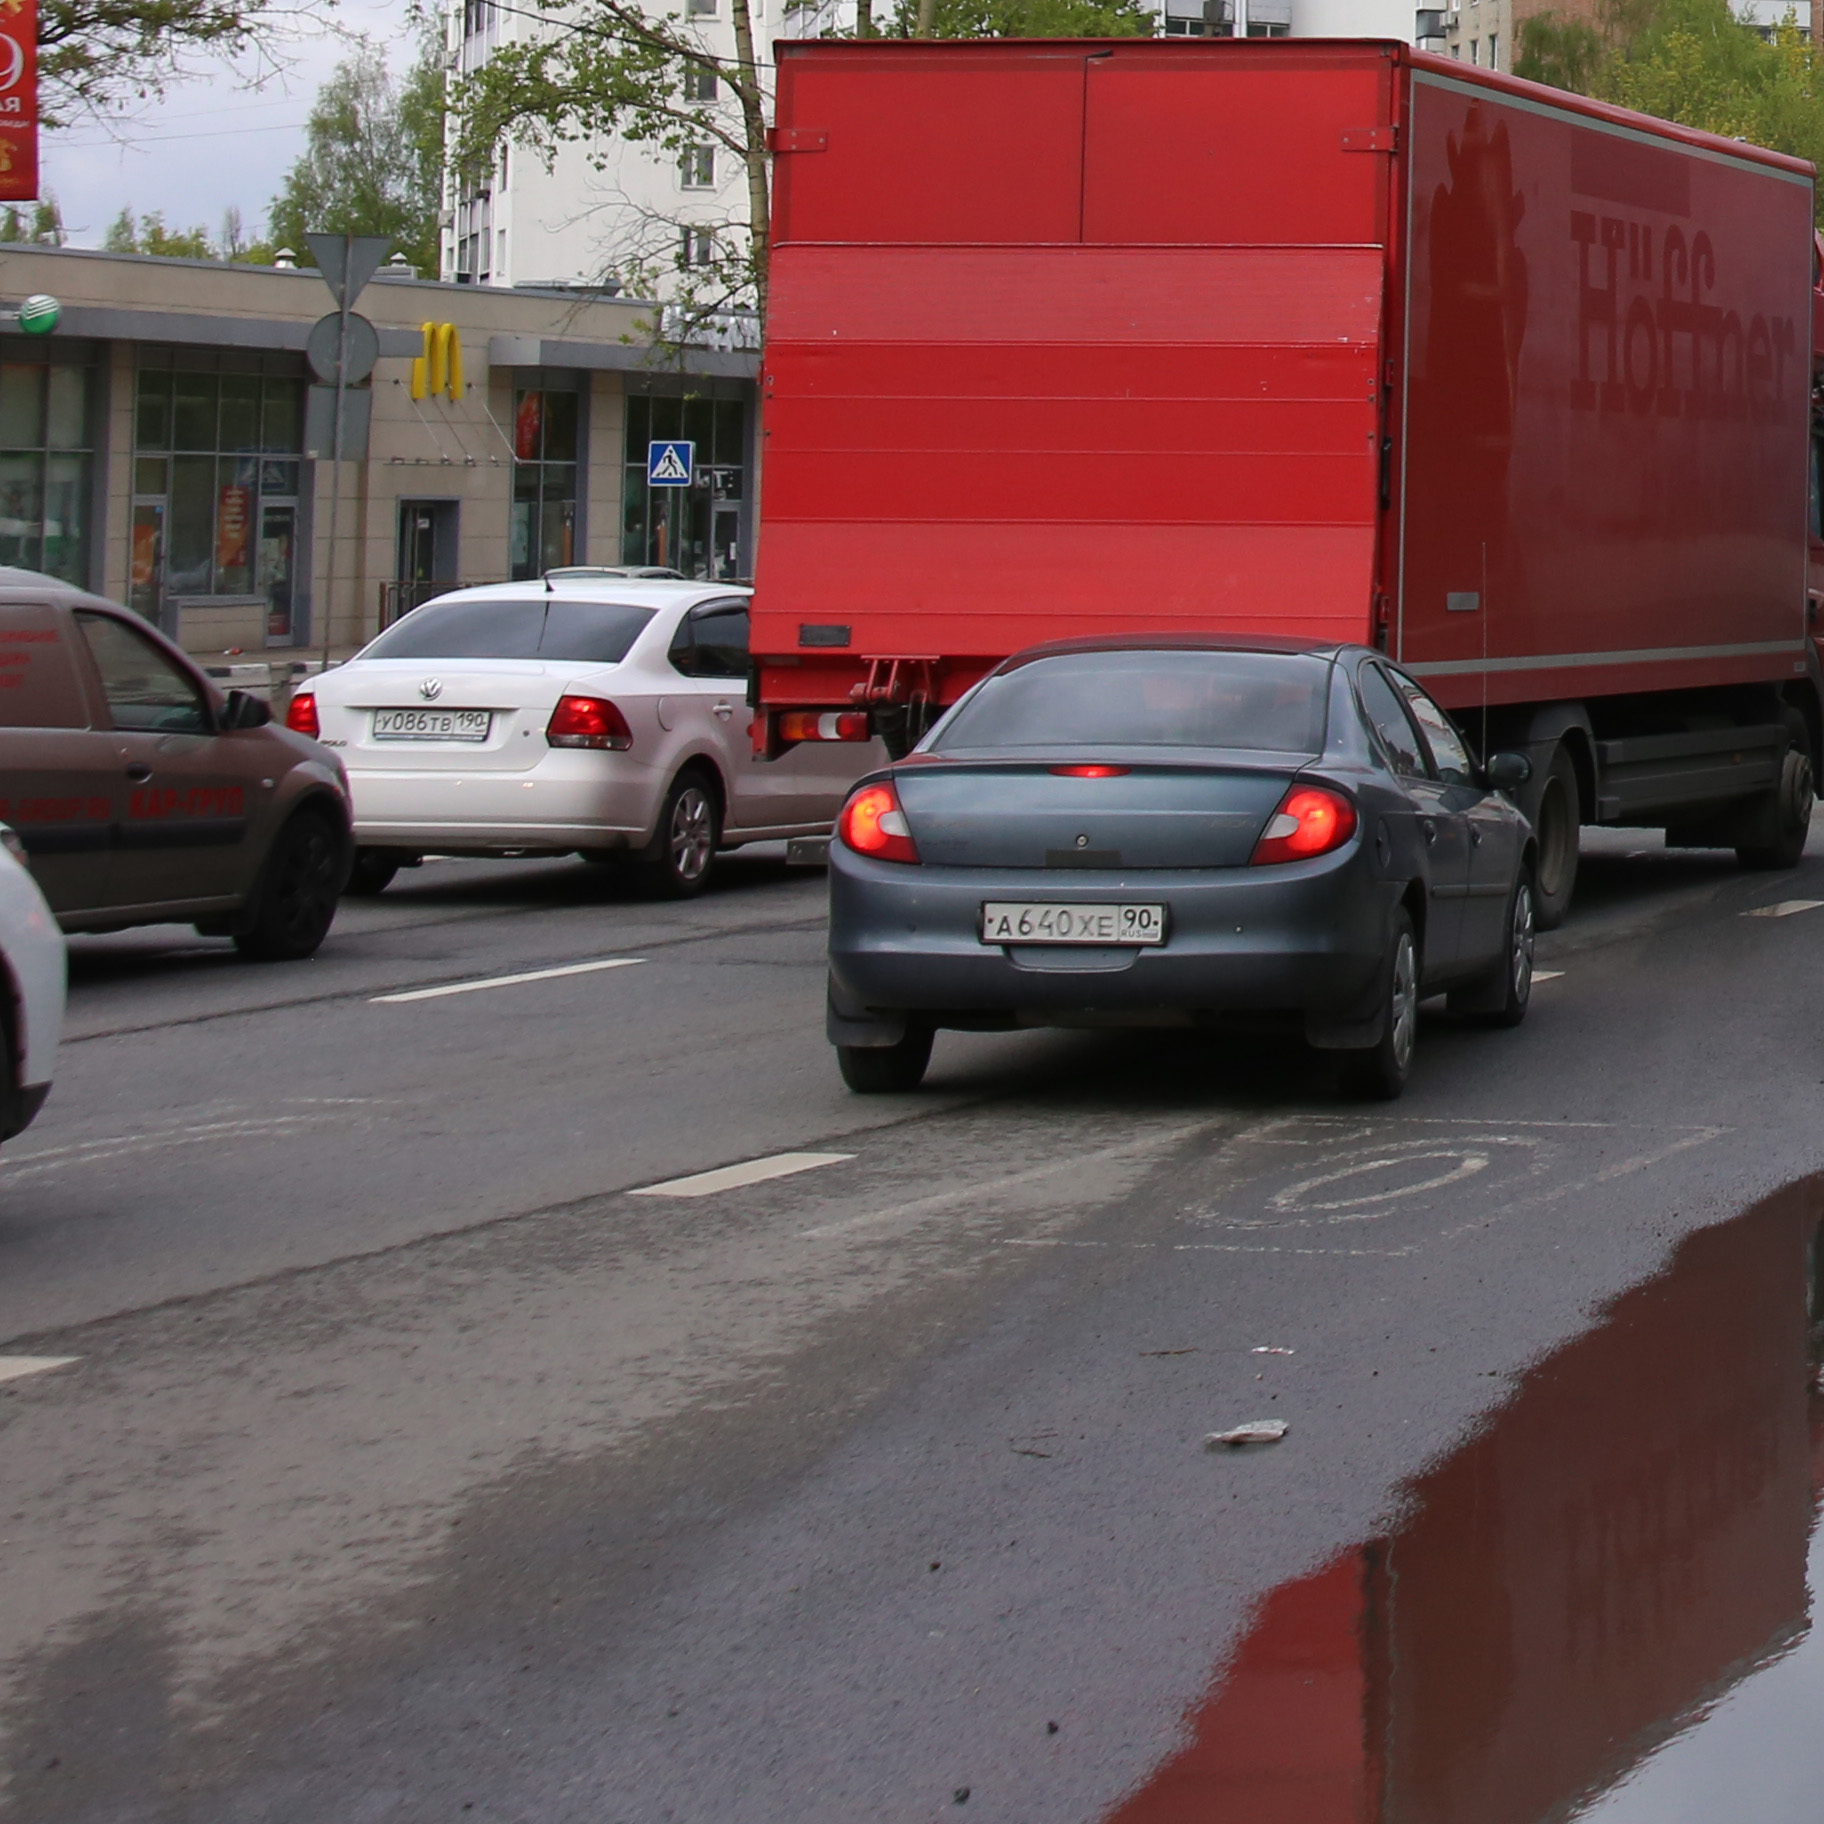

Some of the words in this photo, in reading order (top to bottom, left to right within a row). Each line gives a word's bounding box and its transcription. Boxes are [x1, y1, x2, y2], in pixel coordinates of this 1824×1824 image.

[457, 712, 485, 727] 190
[996, 908, 1114, 938] А640ХЕ
[1123, 908, 1152, 929] 90
[1120, 930, 1142, 938] RUS
